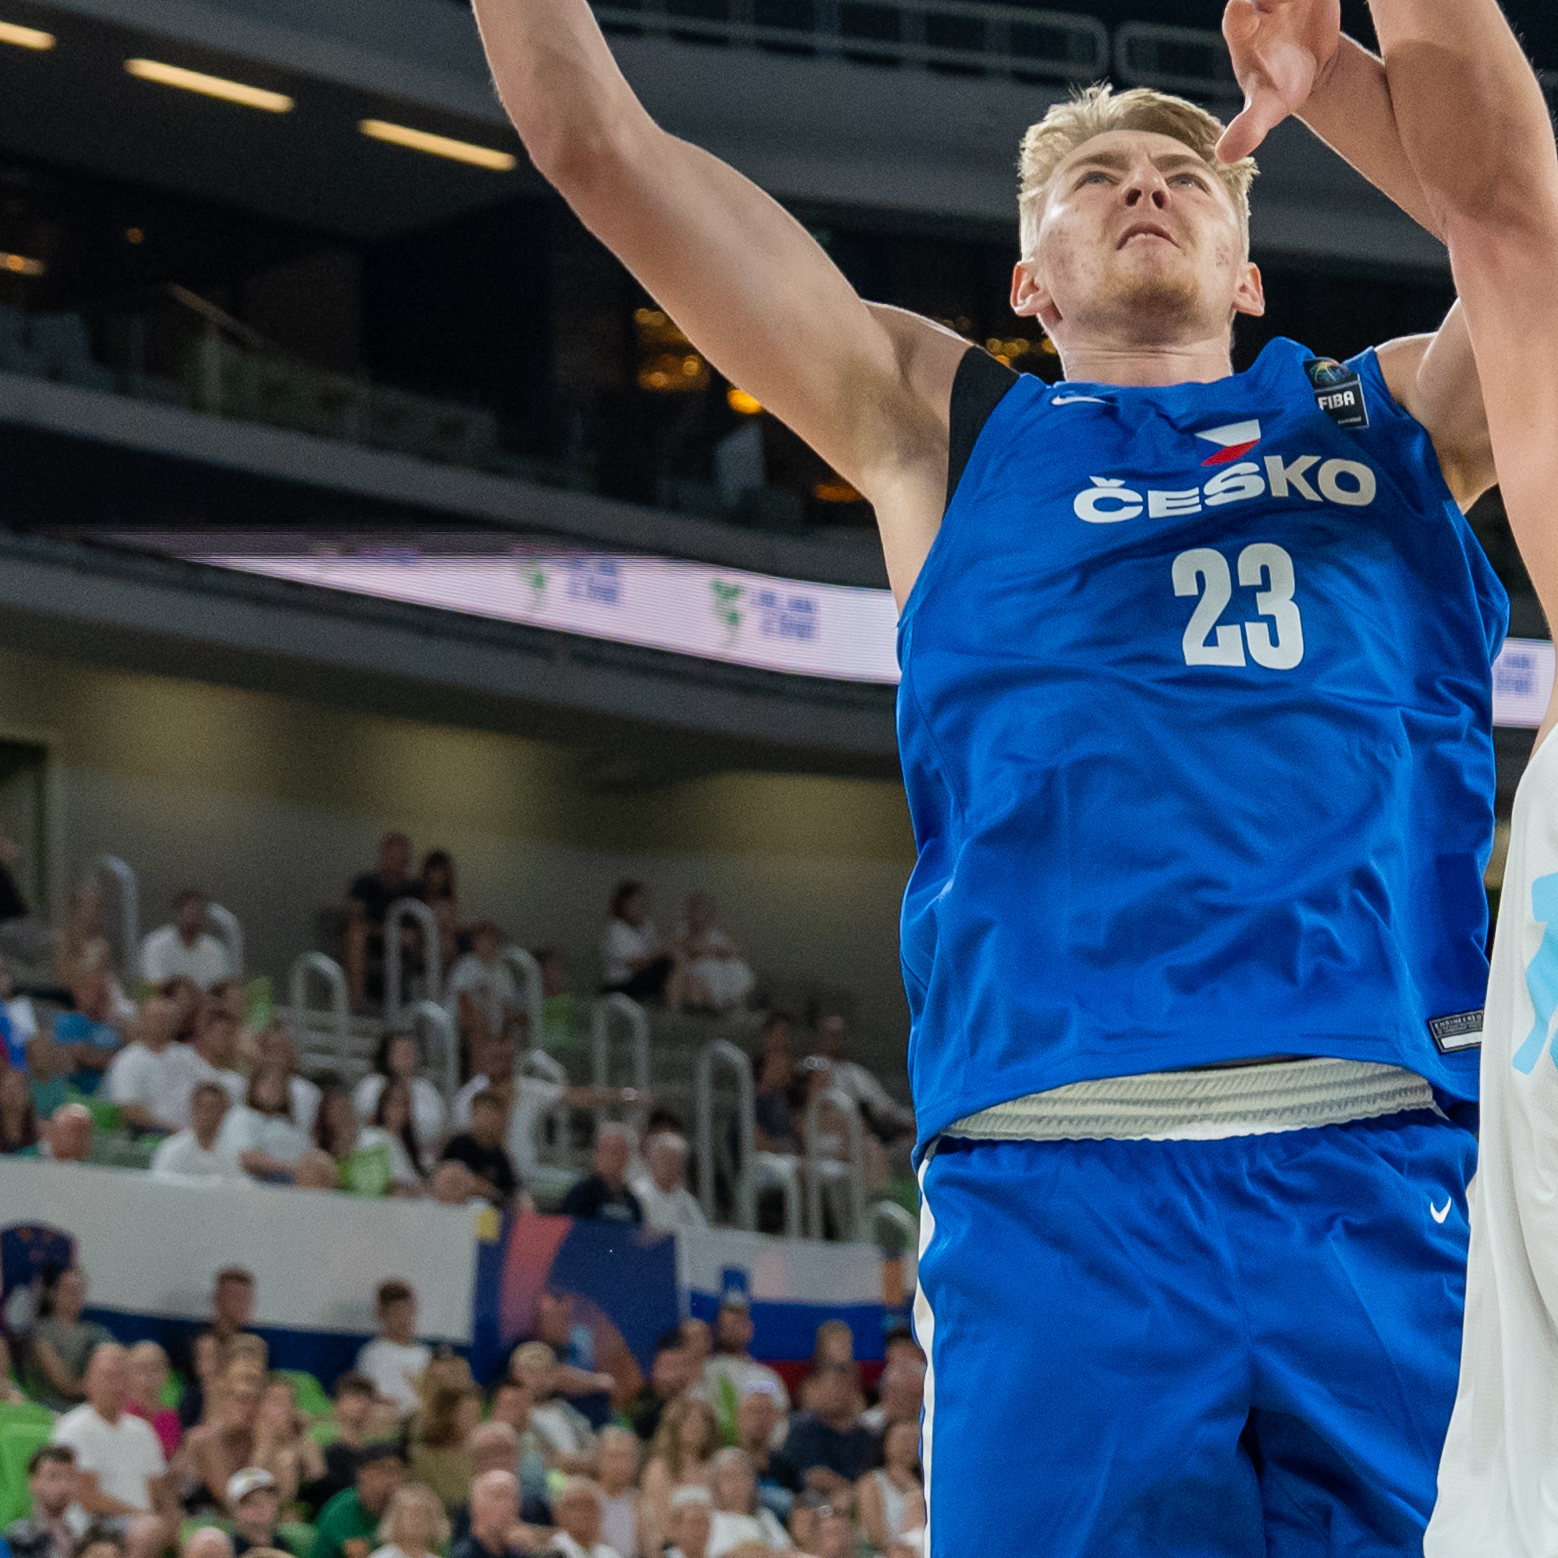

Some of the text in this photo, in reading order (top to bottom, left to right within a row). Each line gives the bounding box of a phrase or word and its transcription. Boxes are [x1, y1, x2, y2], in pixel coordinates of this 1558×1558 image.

[1318, 390, 1355, 411] FIBA
[1073, 455, 1377, 524] ČESKO
[1171, 542, 1304, 670] 23
